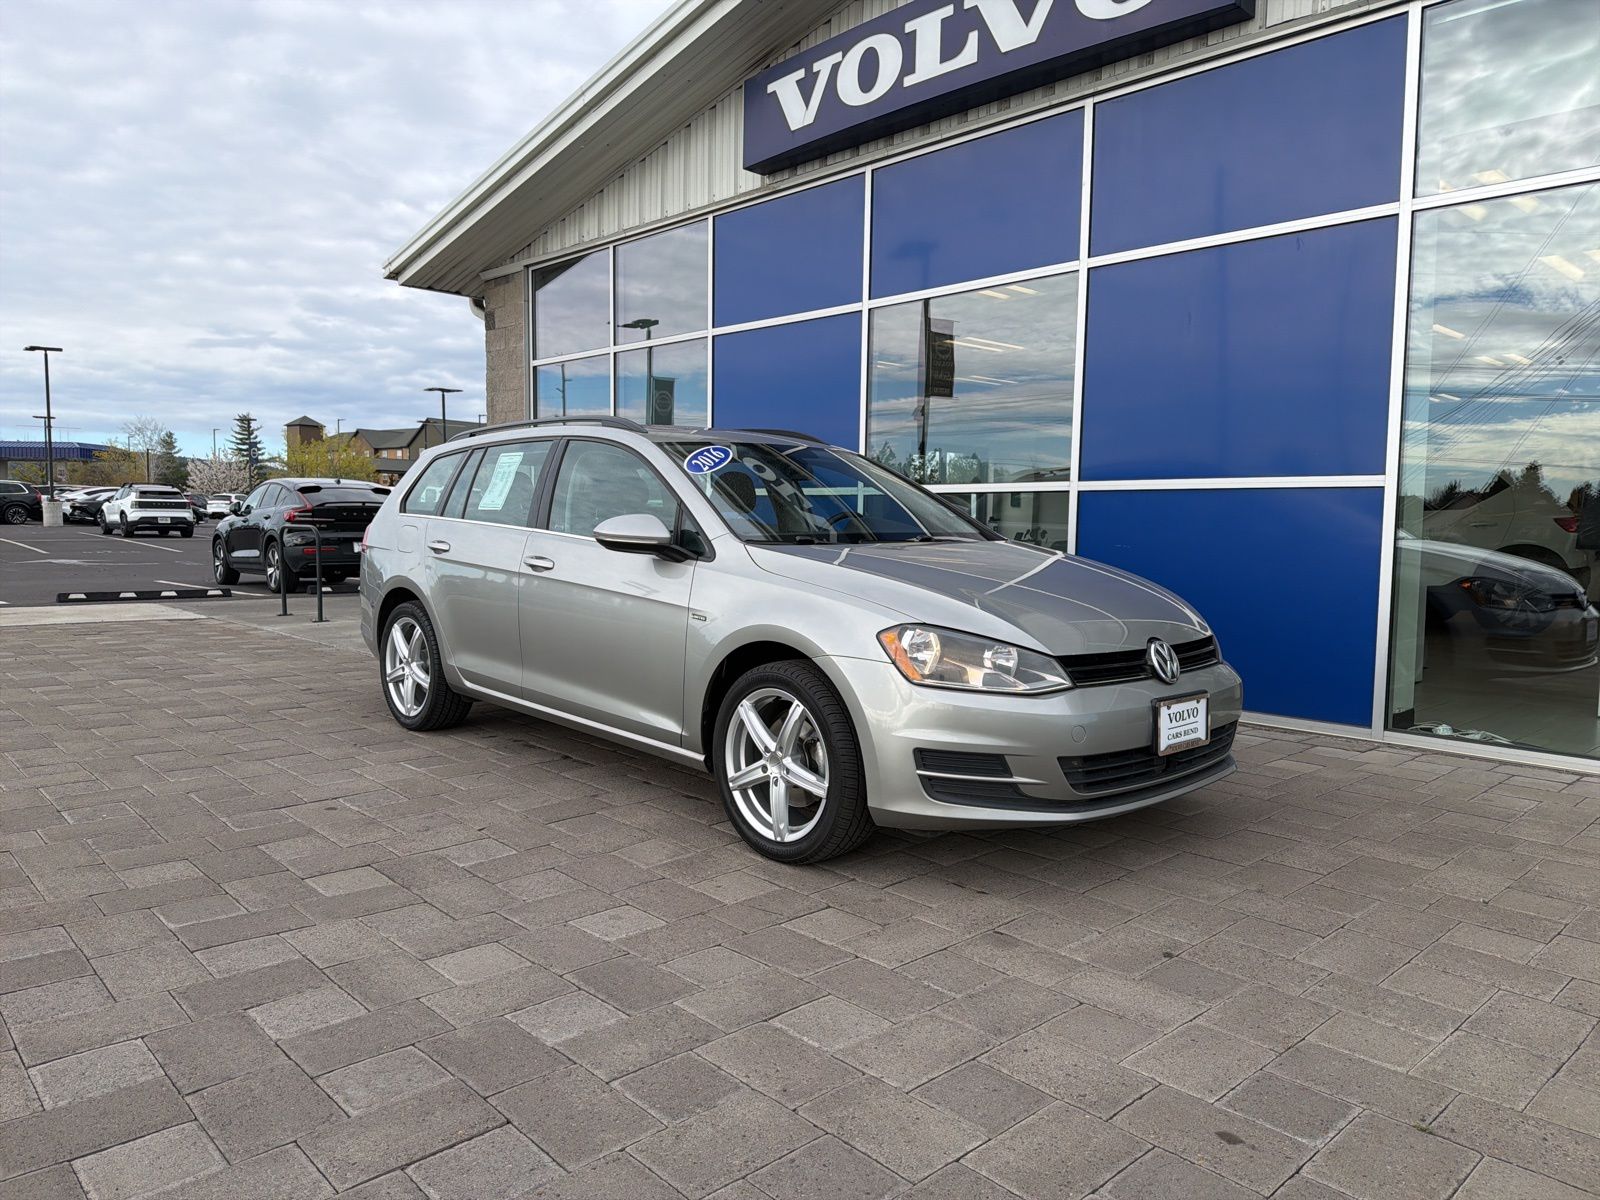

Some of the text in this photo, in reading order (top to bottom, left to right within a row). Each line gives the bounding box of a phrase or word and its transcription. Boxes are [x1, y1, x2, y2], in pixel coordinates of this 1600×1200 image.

[767, 0, 1152, 131] VOLV
[691, 447, 725, 472] 2016
[1167, 706, 1199, 724] VOLVO
[1167, 727, 1199, 741] CARS BEND
